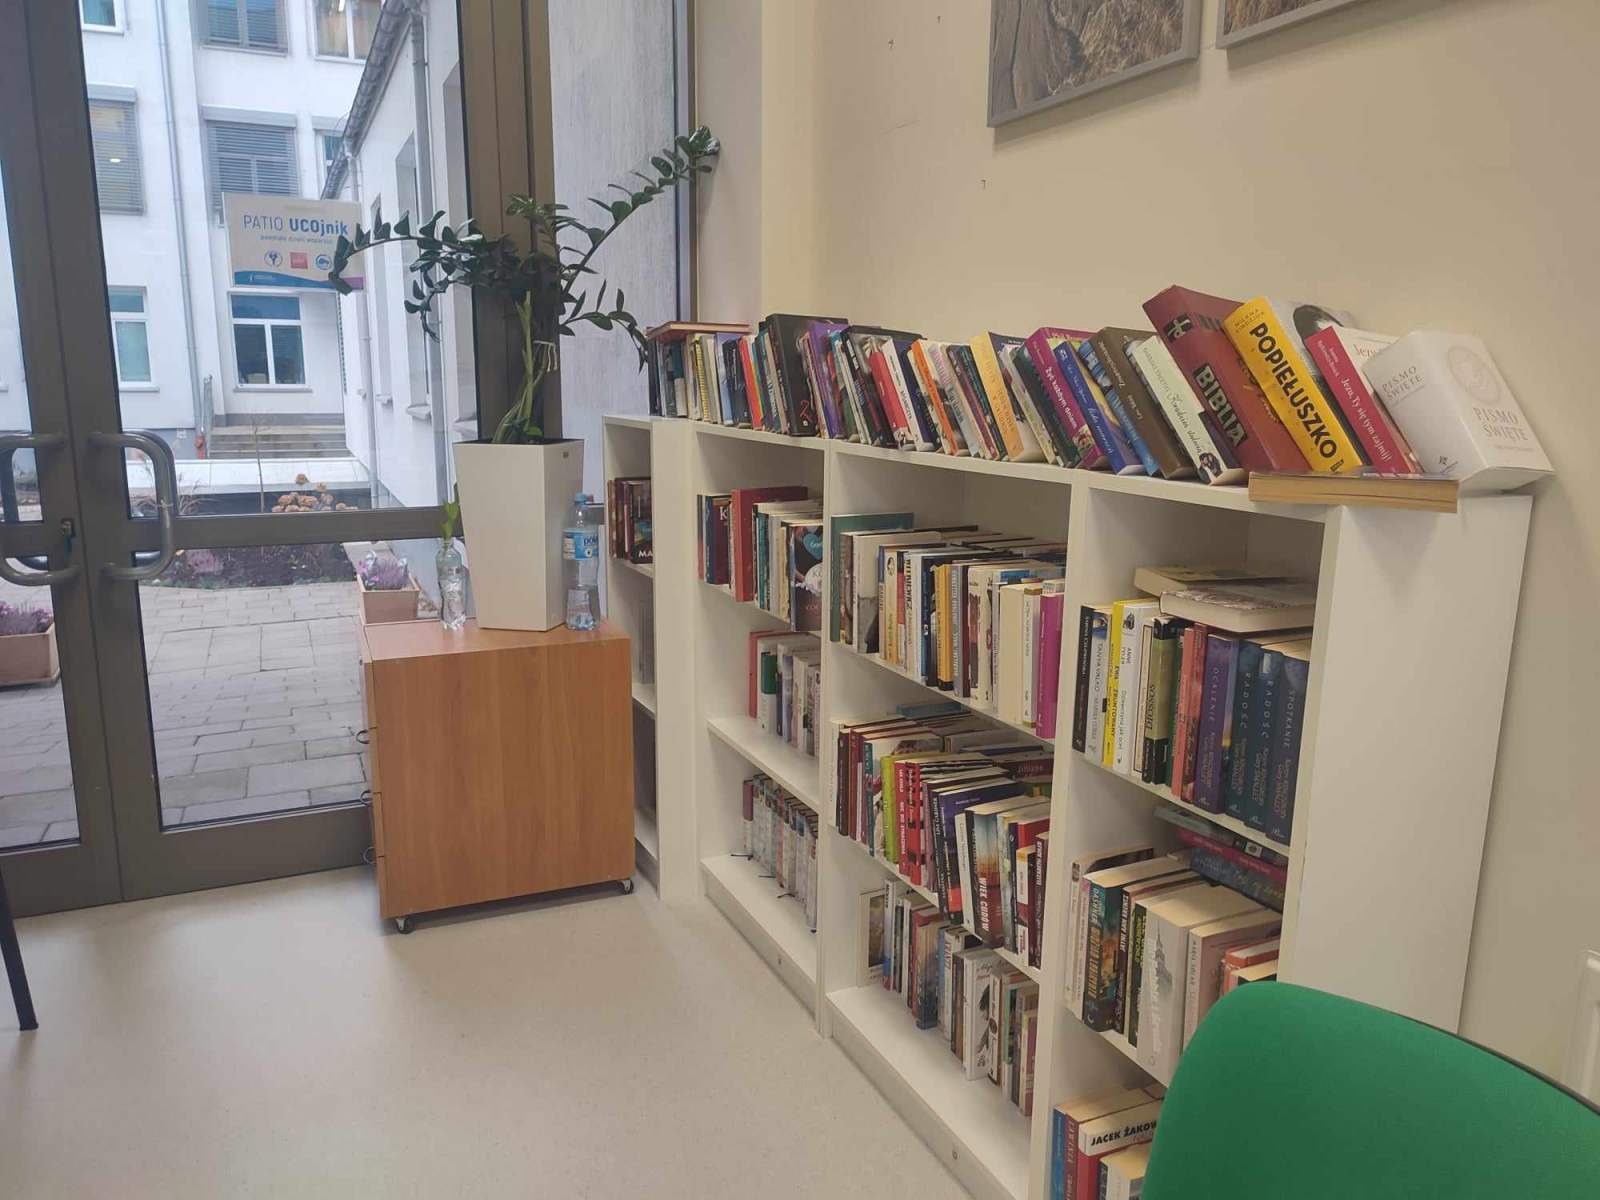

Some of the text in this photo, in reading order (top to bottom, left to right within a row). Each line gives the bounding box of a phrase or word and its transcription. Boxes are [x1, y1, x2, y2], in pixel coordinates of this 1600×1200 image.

[243, 215, 348, 236] PATIO UCOjnik
[1249, 322, 1337, 459] POPIEŁUSZKO
[1339, 376, 1357, 401] Jezu,
[1382, 365, 1417, 391] PISMO
[1386, 374, 1424, 401] ŚWIĘTE
[1196, 367, 1246, 446] BIBLIA
[1357, 406, 1369, 420] się
[1473, 407, 1519, 423] PISMO
[1362, 418, 1377, 436] tym
[1483, 425, 1529, 442] ŚWIĘTE
[1095, 642, 1103, 668] TANYA
[1261, 679, 1273, 740] RADOŚĆ
[1284, 689, 1295, 750] SPOTKANIE
[979, 877, 989, 932] WIEK CUDÓW
[1091, 887, 1099, 923] DASHNER
[1090, 1130, 1121, 1146] JACEK
